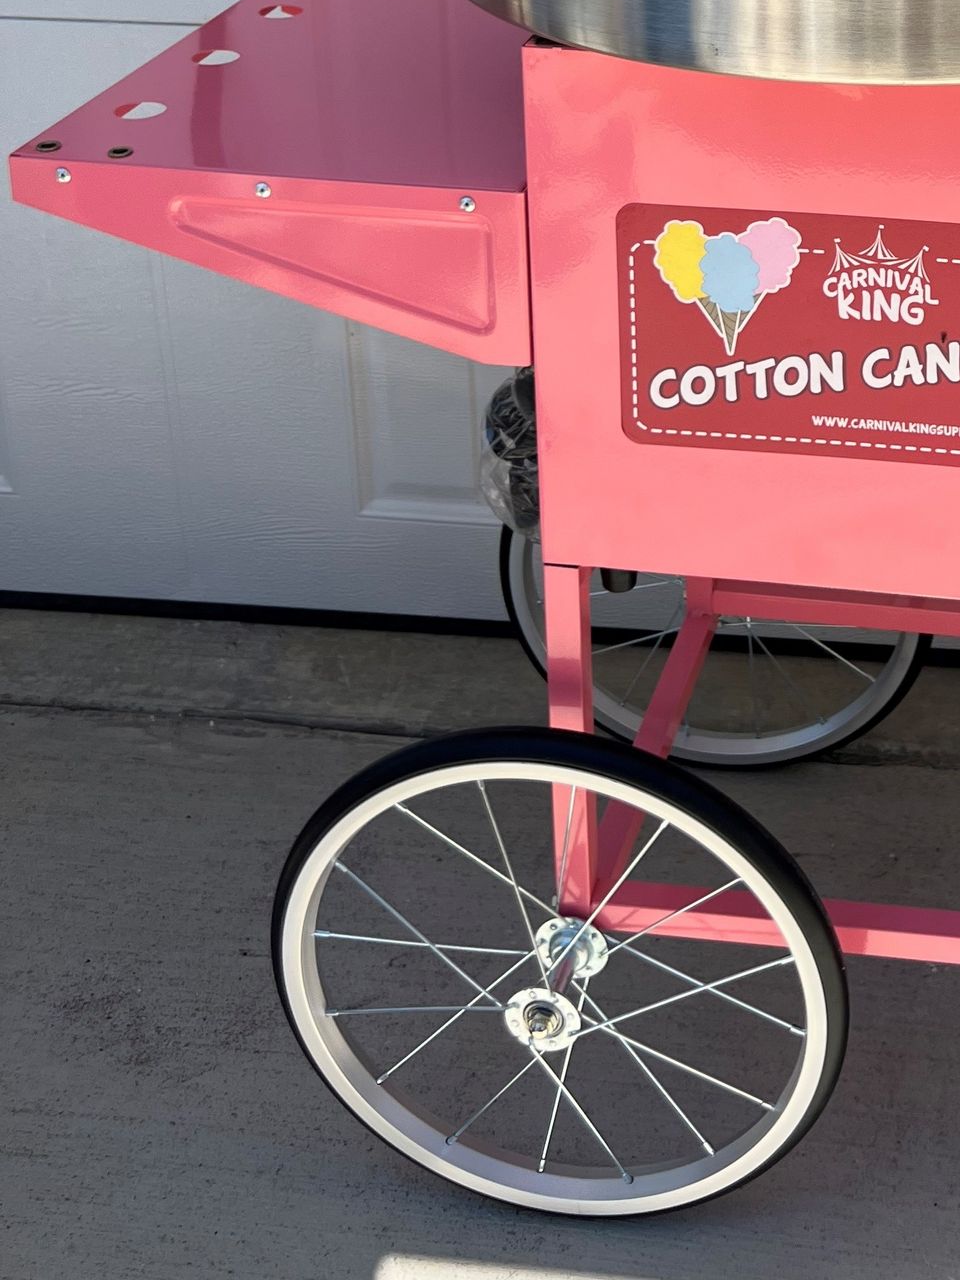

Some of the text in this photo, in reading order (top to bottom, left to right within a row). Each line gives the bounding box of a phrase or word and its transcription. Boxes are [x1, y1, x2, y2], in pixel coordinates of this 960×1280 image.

[823, 268, 939, 305] CARNIVAL
[838, 289, 925, 326] KING
[650, 351, 844, 409] COTTON
